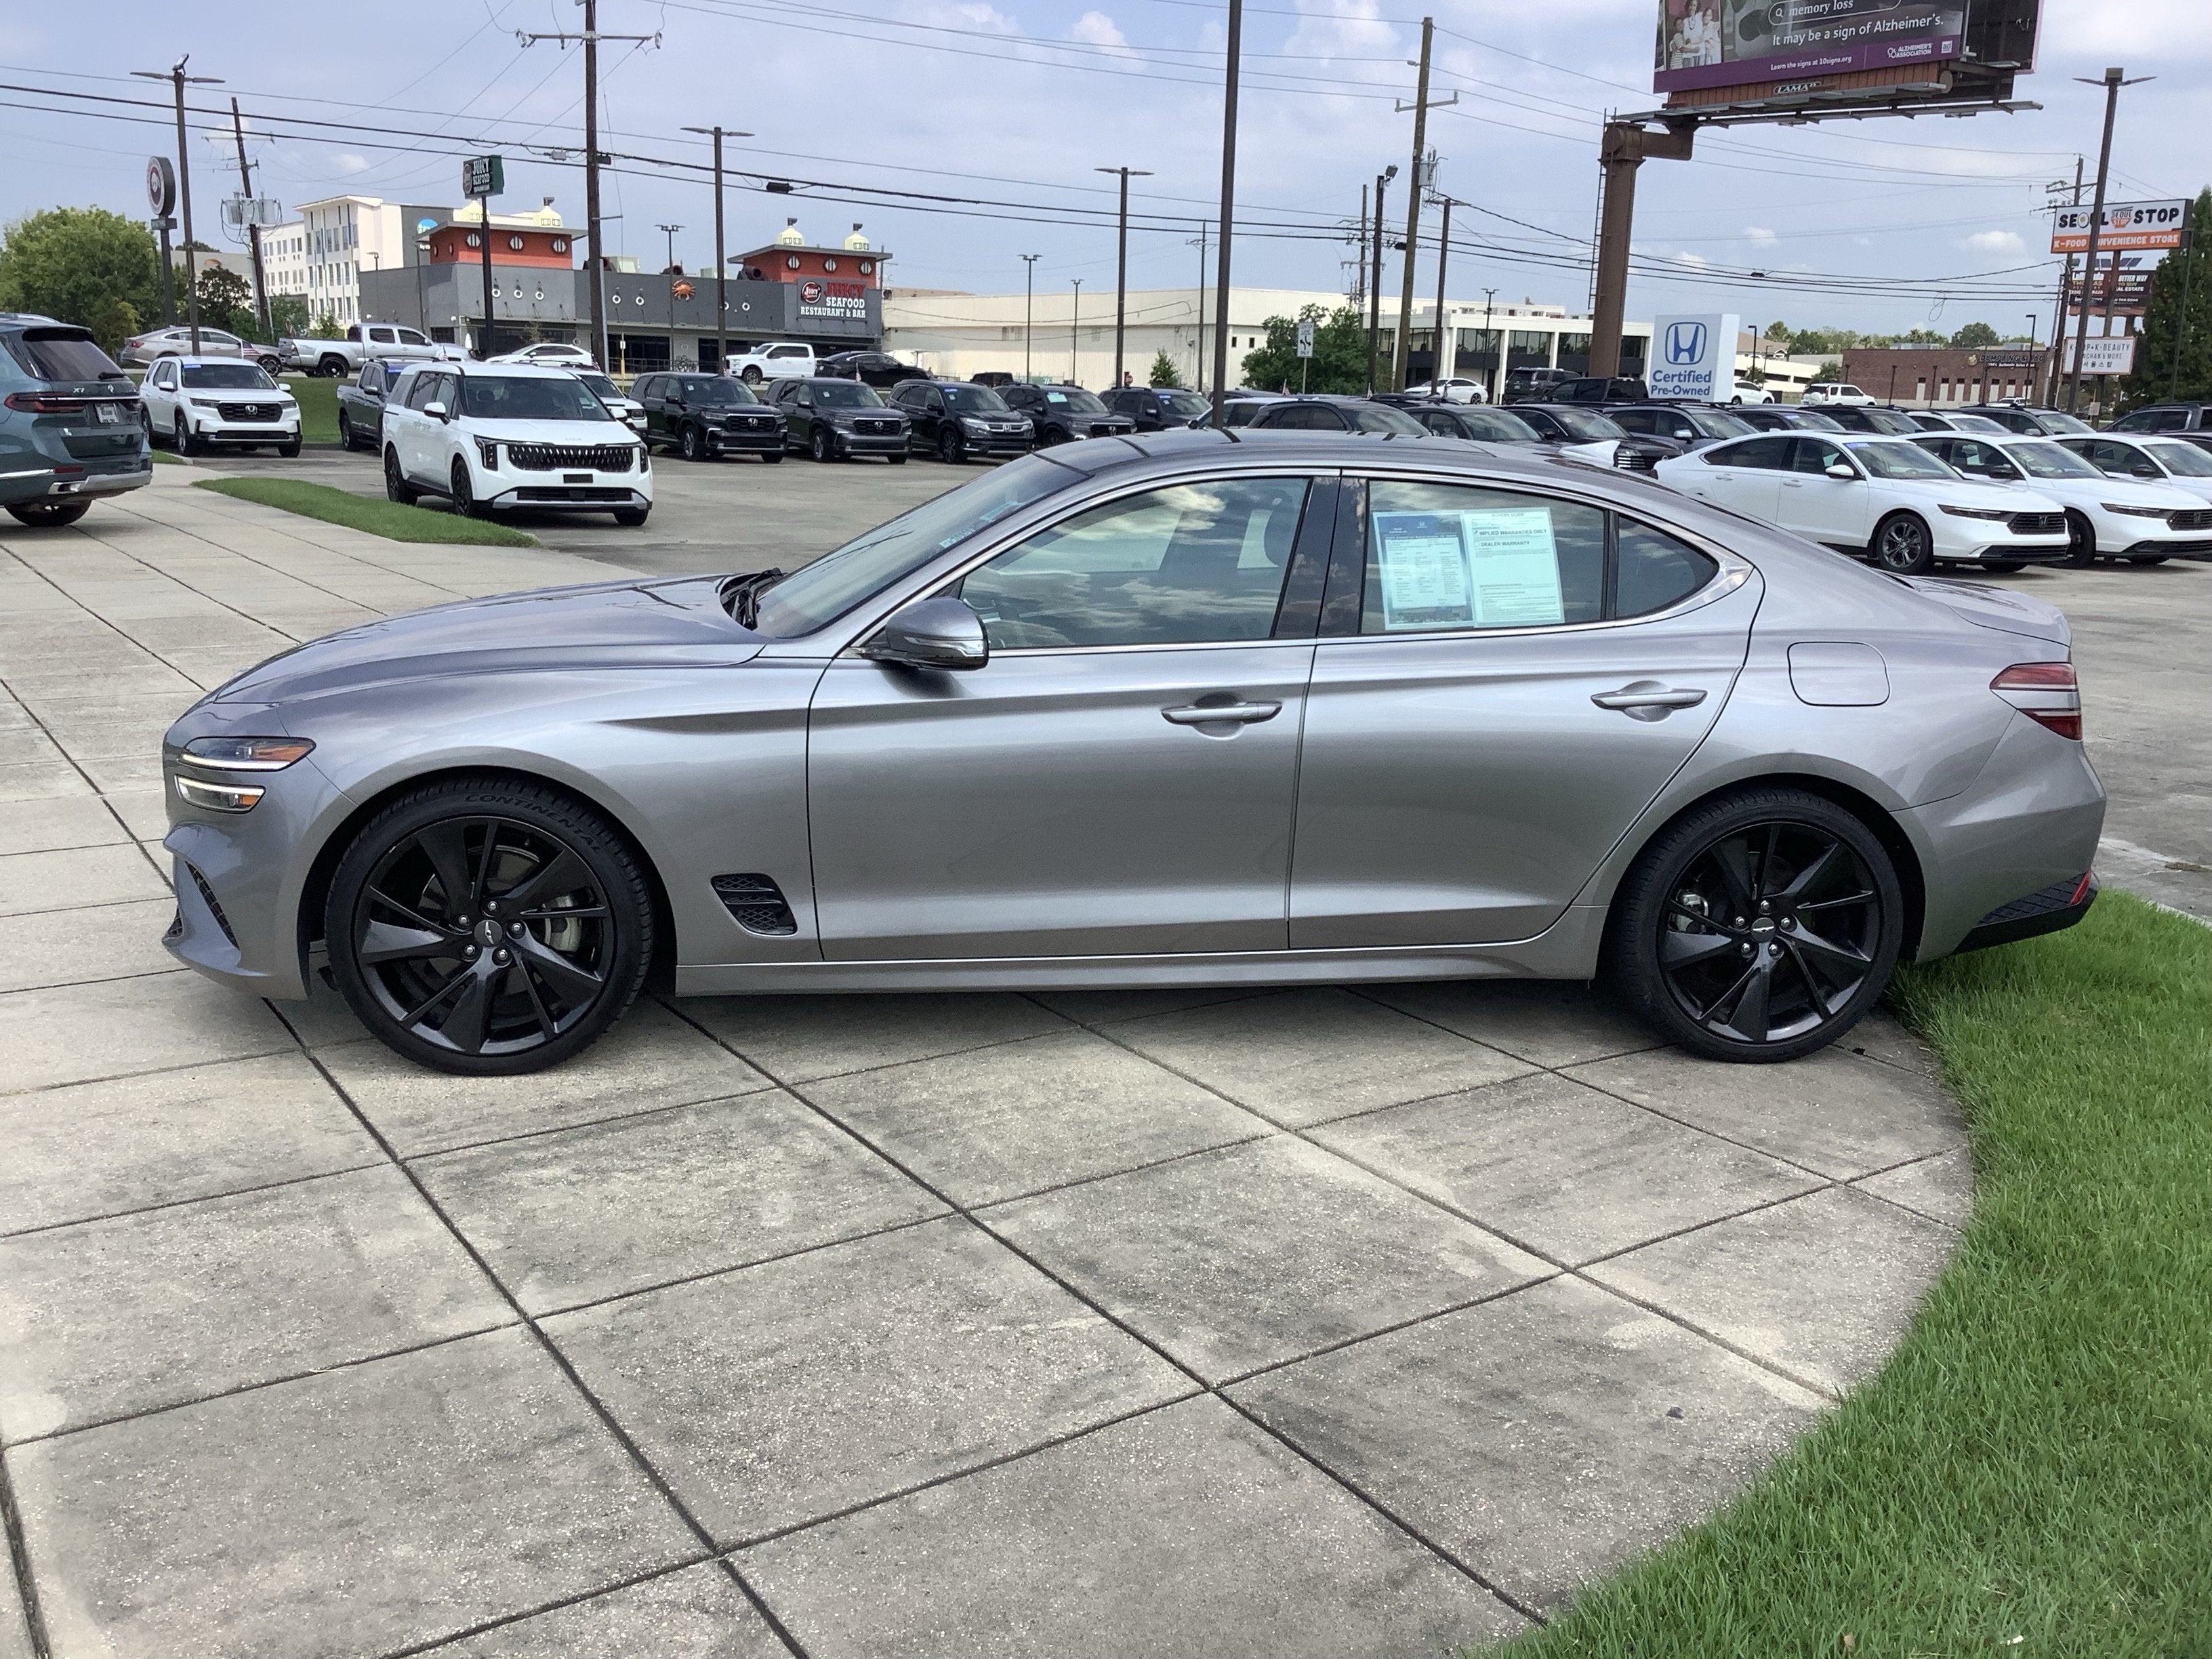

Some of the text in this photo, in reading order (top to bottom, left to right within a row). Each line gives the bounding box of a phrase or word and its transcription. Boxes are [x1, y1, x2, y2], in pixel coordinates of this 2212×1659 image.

[1789, 0, 1853, 17] memory loss
[1773, 35, 1780, 45] It
[1783, 33, 1805, 46] may
[1808, 29, 1821, 41] be
[1824, 30, 1830, 39] a
[1833, 25, 1856, 40] sign
[1859, 22, 1872, 35] of
[1896, 49, 1931, 58] ASSOCIATION
[1797, 60, 1811, 68] signs
[1819, 56, 1852, 65] 10signs.org
[472, 159, 489, 175] JUICY
[2133, 207, 2179, 224] STOP
[2053, 234, 2179, 249] K-FOOD NVENIENCE STORE
[824, 282, 865, 299] JUICY
[826, 297, 865, 308] SEAFOOD
[800, 306, 865, 319] RESTAURANT & BAR
[1652, 370, 1712, 383] Certified
[1651, 385, 1710, 395] Pre-Owned
[465, 794, 602, 851] CONTINENTAL
